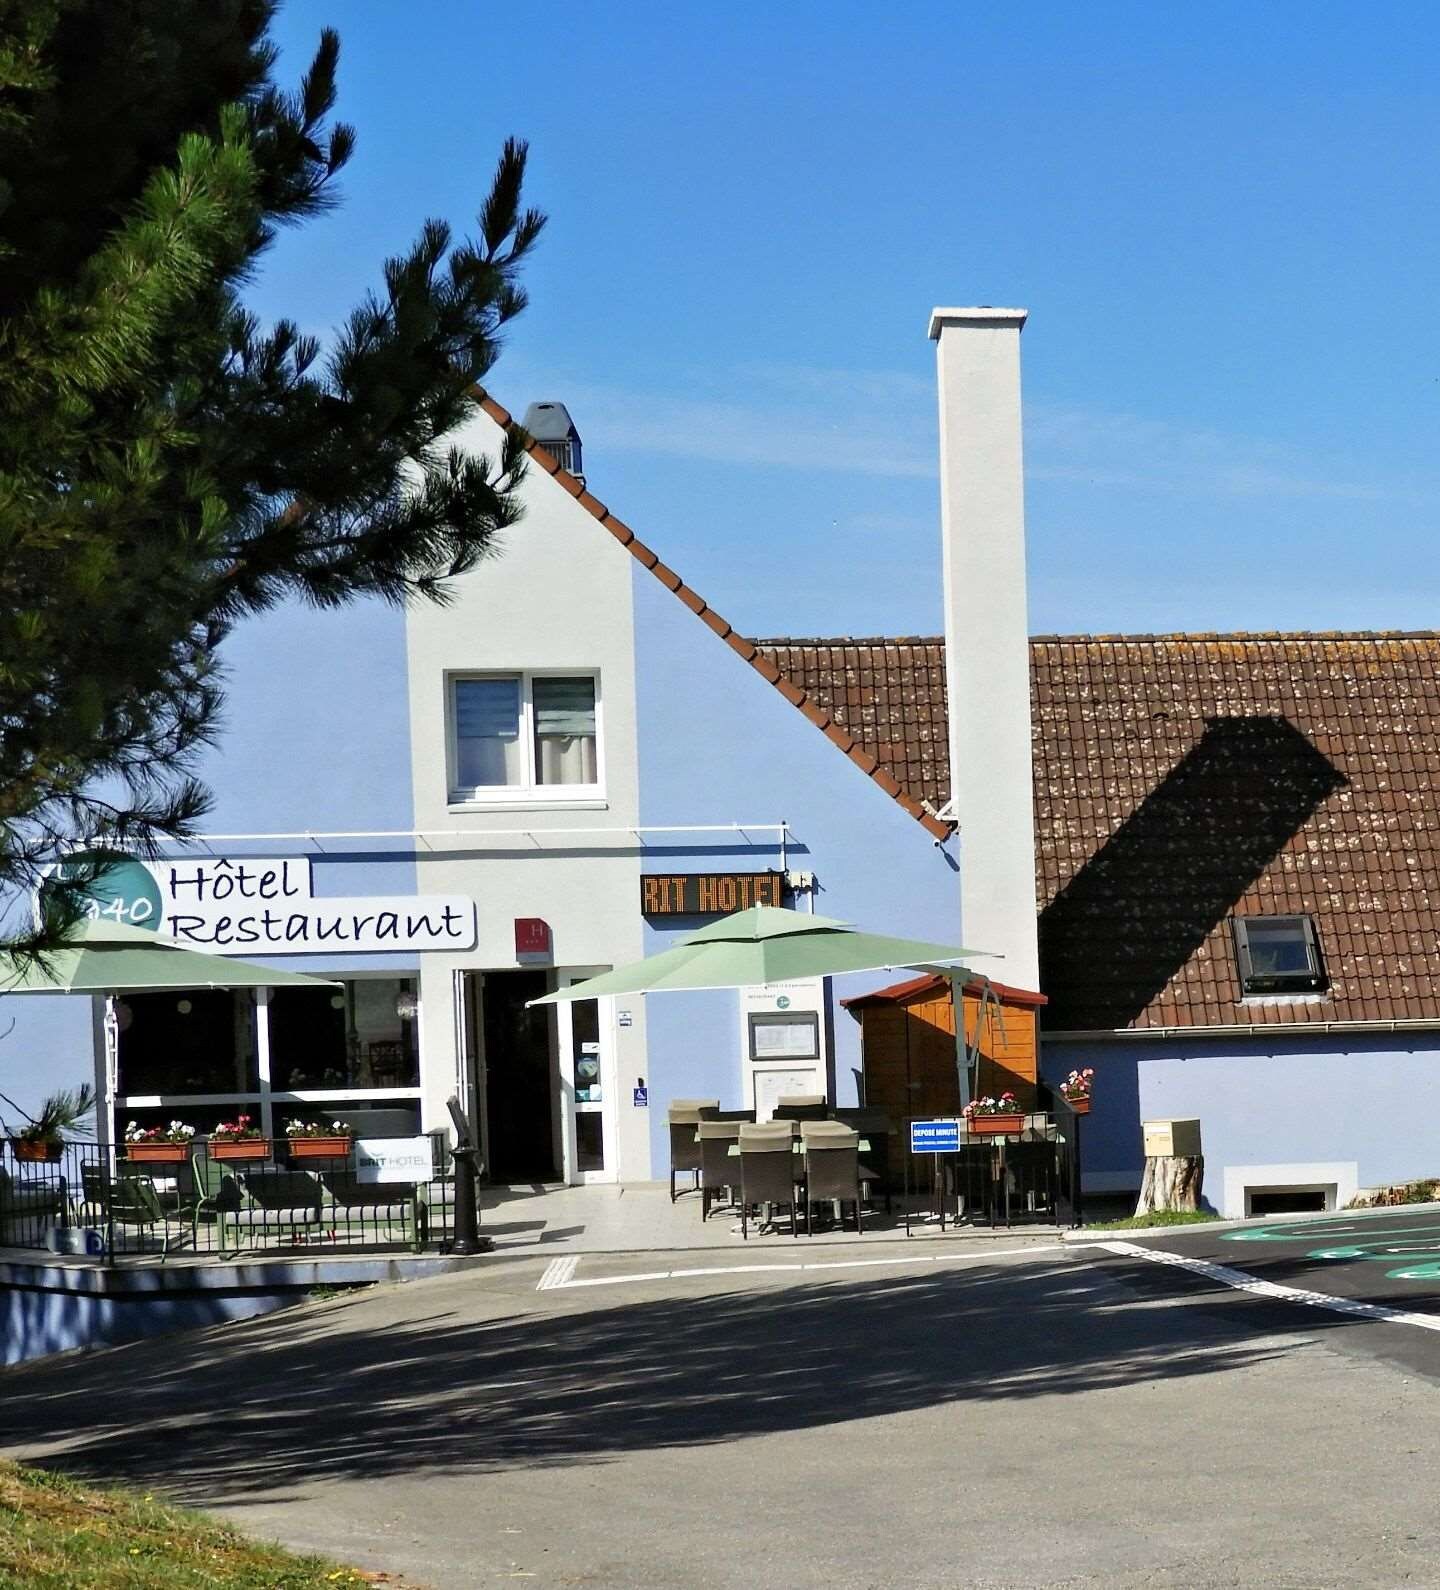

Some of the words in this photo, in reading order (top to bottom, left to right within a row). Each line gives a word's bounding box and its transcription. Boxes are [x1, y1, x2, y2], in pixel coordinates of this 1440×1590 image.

[170, 859, 298, 901] Hôtel
[167, 905, 463, 944] Restaurant
[389, 1155, 429, 1168] HOTEL
